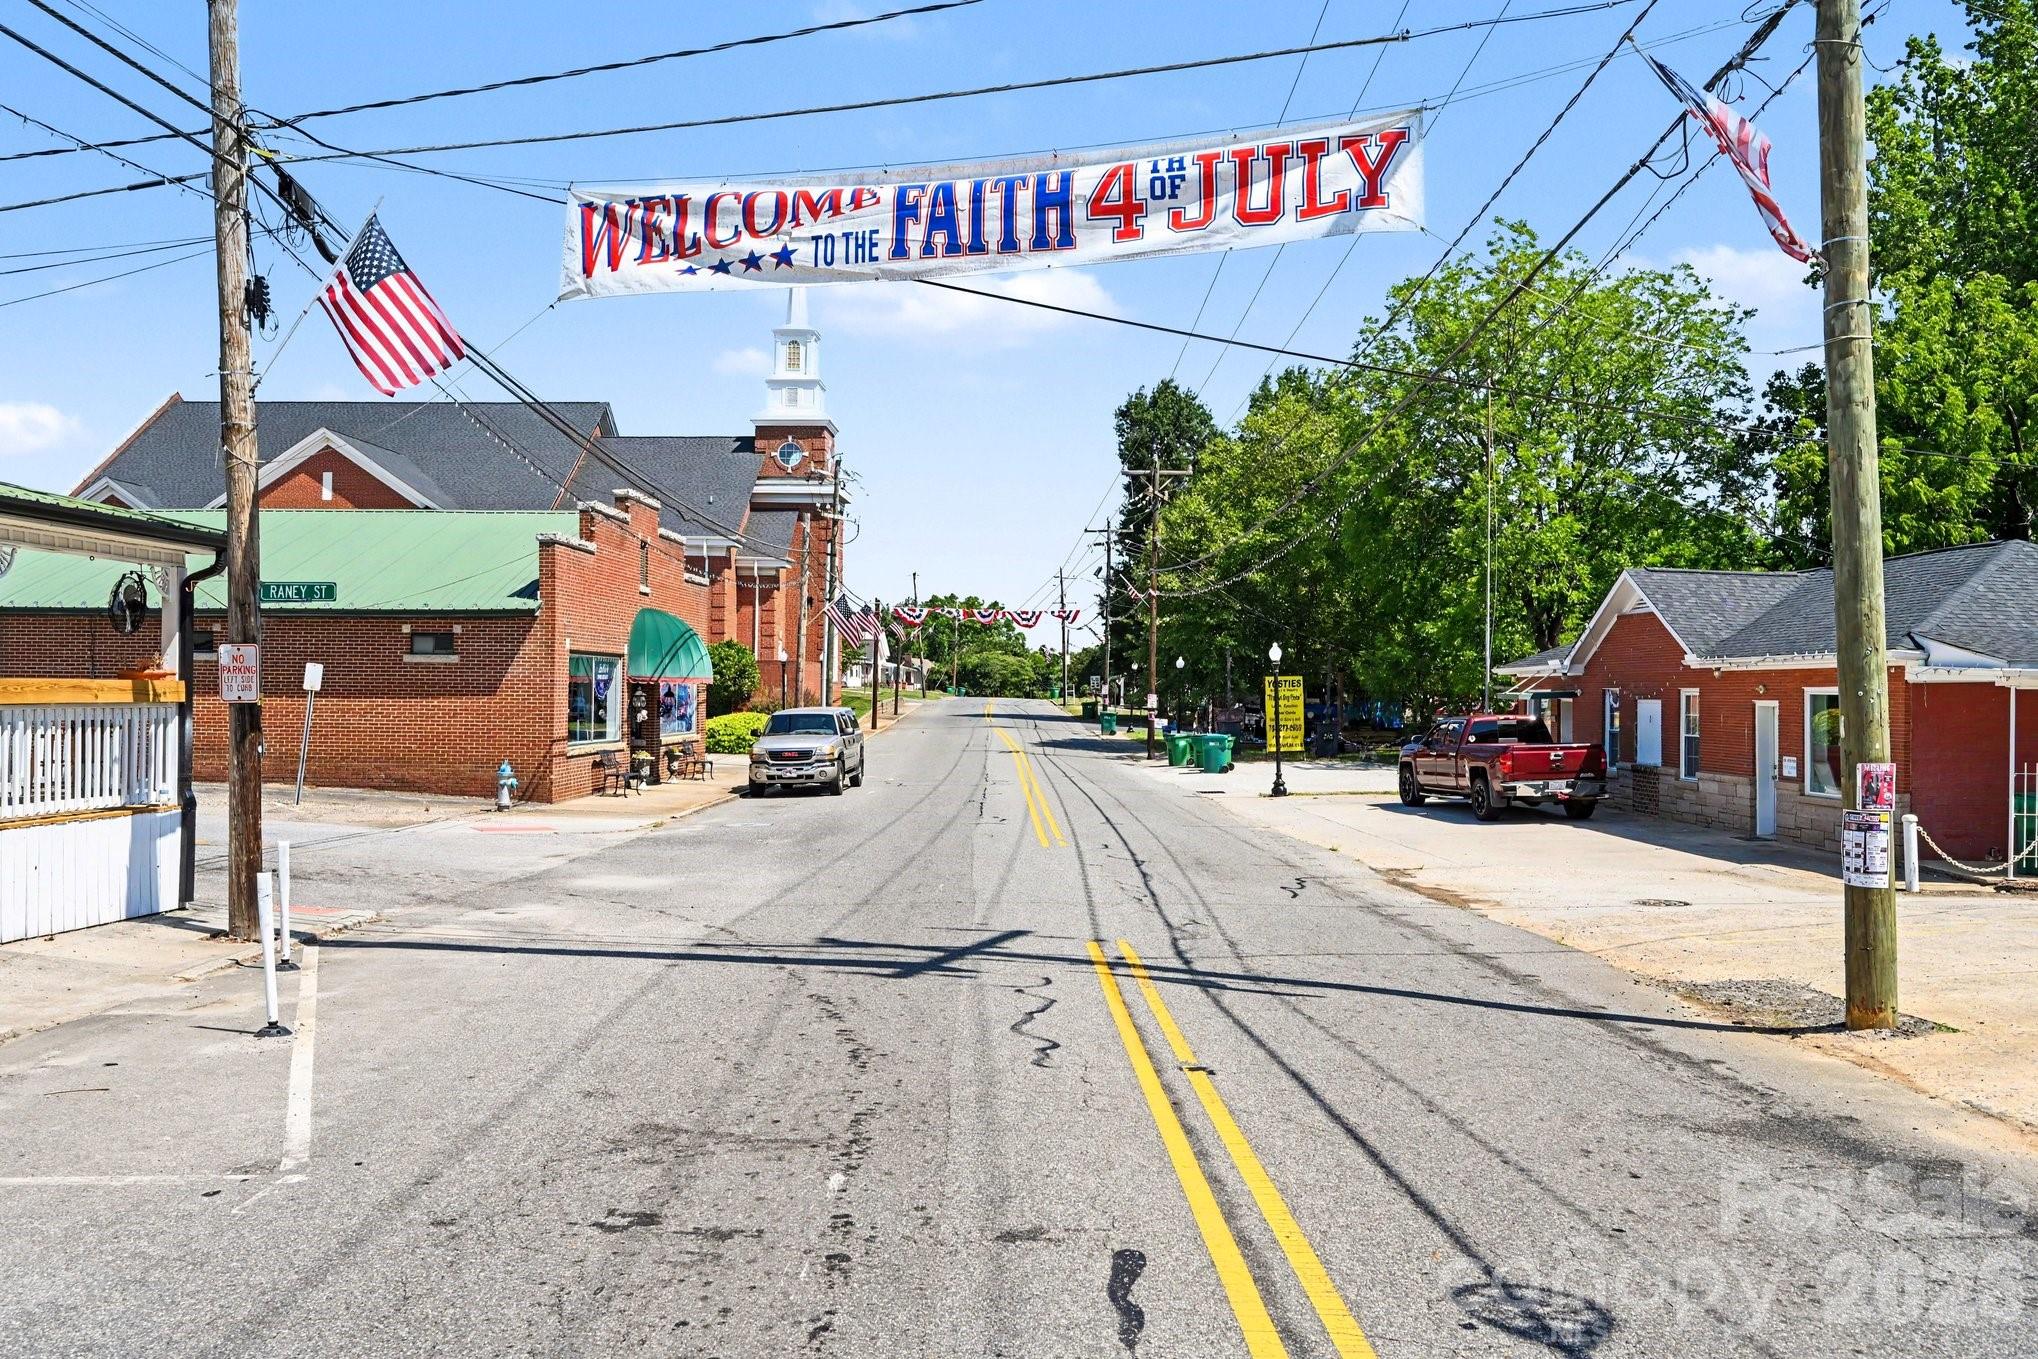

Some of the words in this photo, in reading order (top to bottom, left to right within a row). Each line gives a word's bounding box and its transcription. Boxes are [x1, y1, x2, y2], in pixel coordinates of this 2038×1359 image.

[1149, 173, 1187, 201] OF
[1167, 126, 1411, 234] JULY
[1086, 160, 1149, 244] 4
[1147, 155, 1187, 173] TH
[888, 168, 1078, 261] FAITH
[578, 186, 881, 279] WELCOME
[811, 234, 835, 268] TO
[841, 228, 880, 265] THE
[270, 585, 307, 599] RANEY
[313, 585, 327, 599] ST
[222, 665, 256, 675] PARKING
[232, 654, 245, 664] NO
[223, 675, 239, 683] LEFT
[241, 675, 255, 683] SIDE
[226, 684, 234, 692] TO
